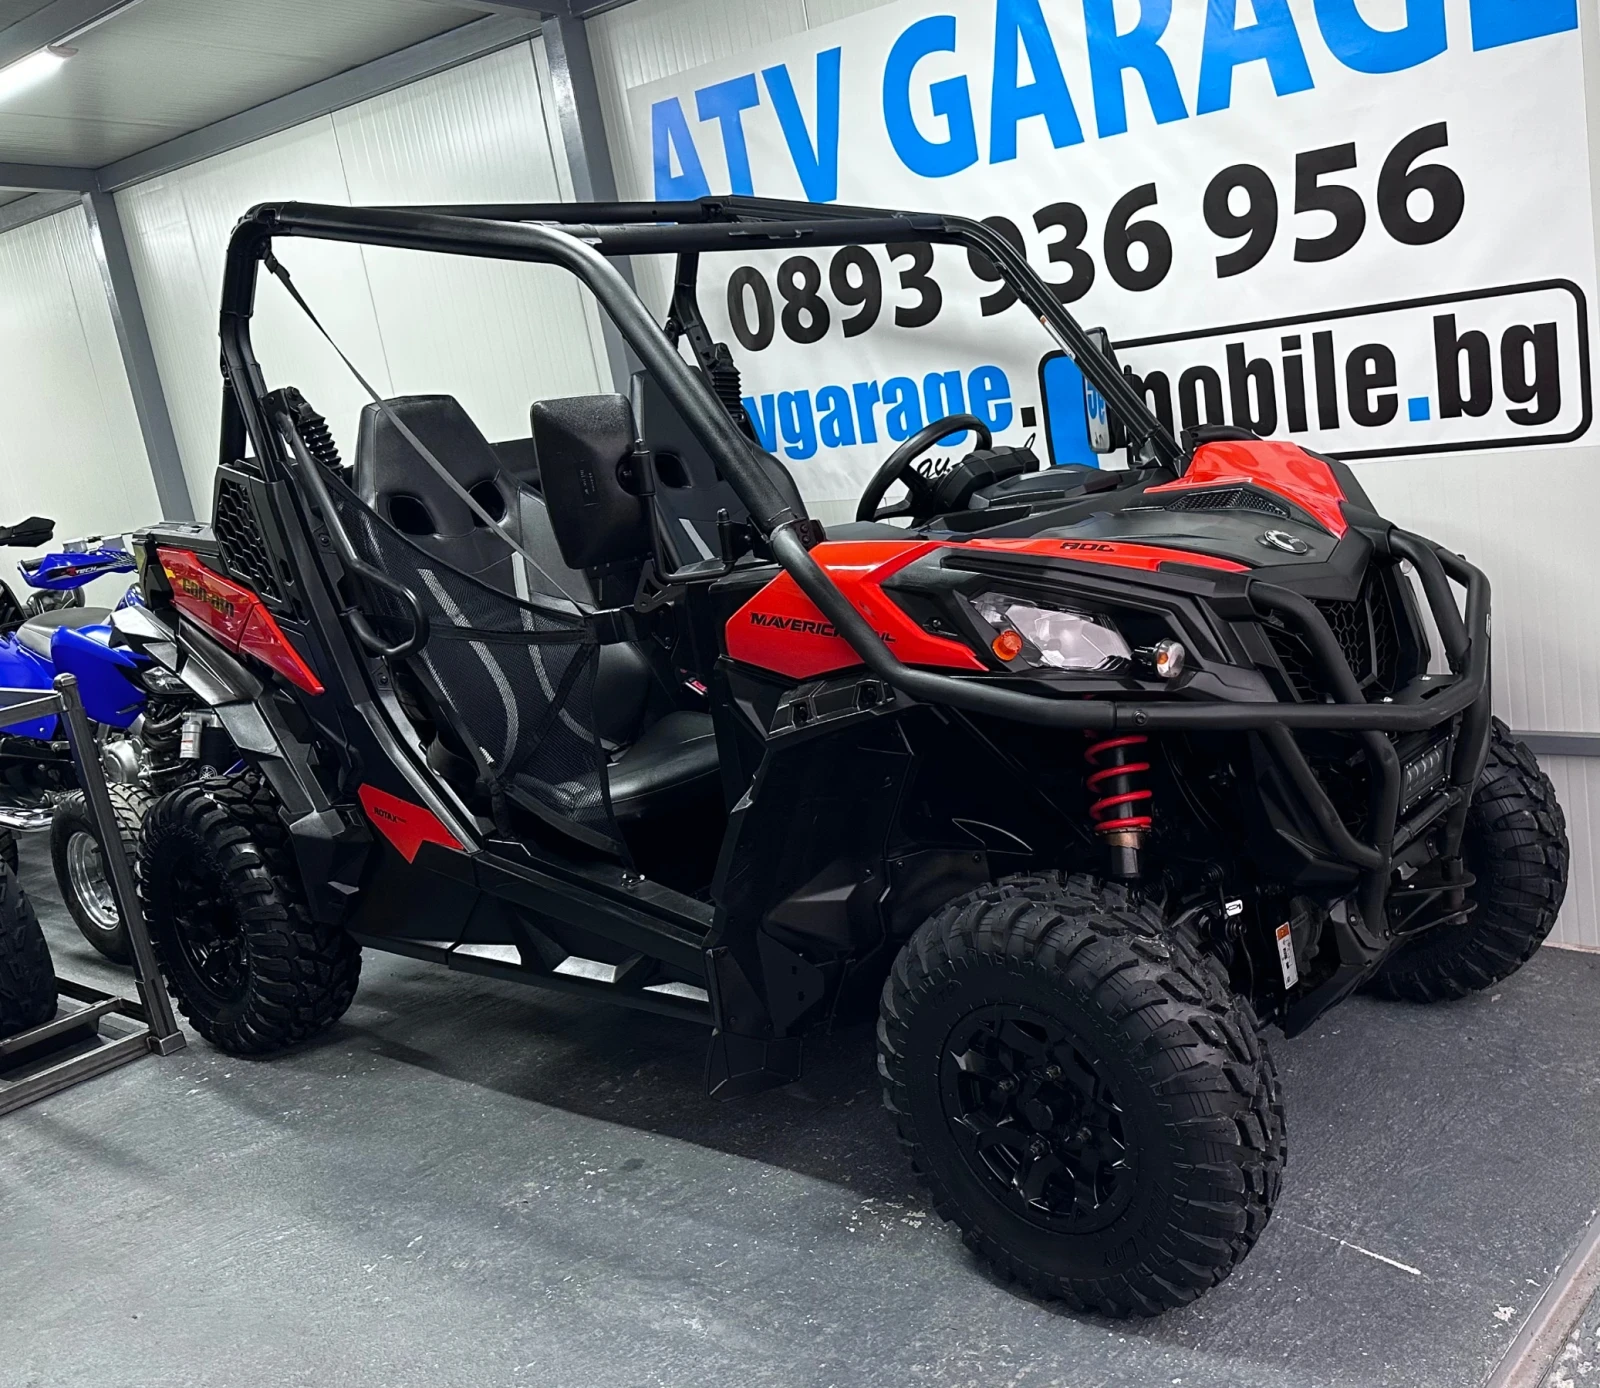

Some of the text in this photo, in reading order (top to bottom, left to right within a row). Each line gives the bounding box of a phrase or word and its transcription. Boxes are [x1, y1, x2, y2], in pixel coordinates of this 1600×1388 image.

[652, 0, 1578, 204] ATV GARA
[727, 122, 1465, 351] 0893 936 956
[751, 612, 844, 638] MAVERIC
[373, 807, 398, 824] ROTAX
